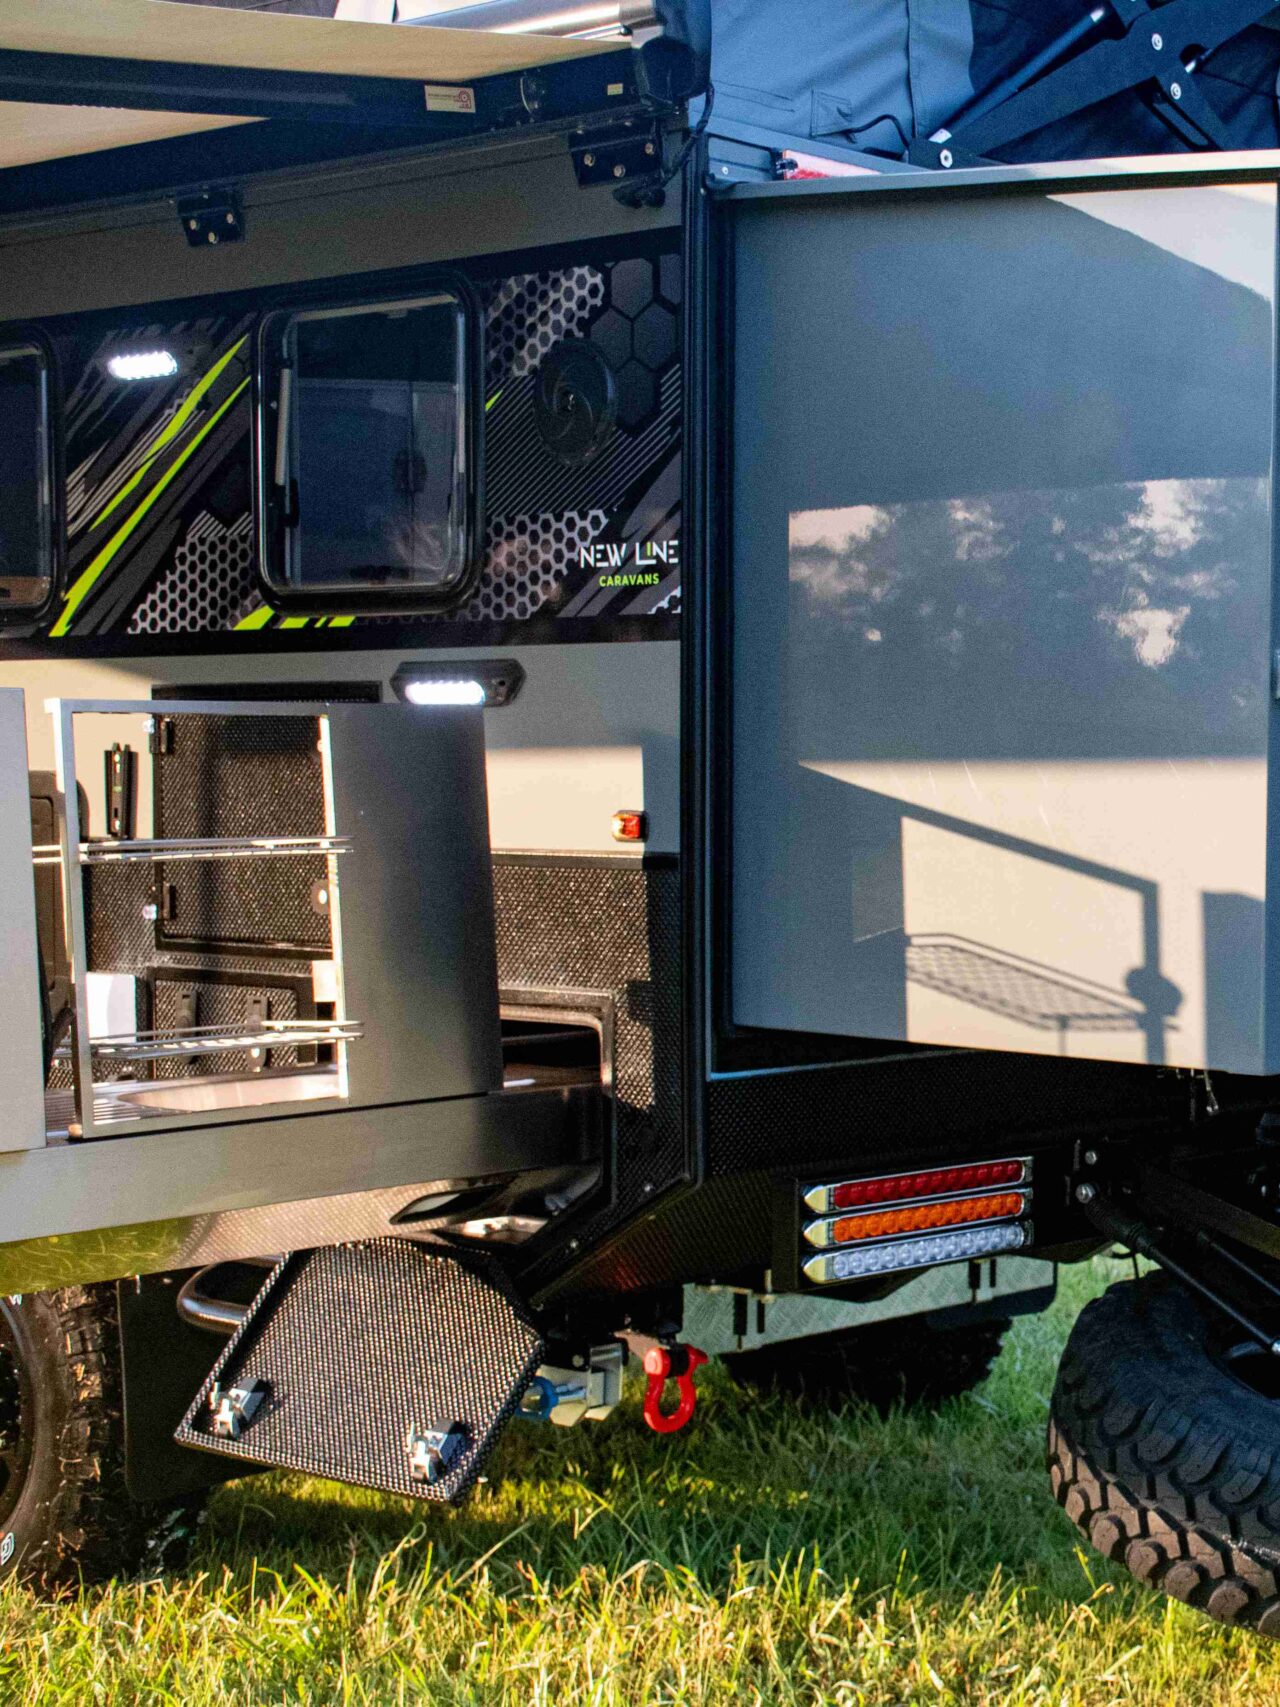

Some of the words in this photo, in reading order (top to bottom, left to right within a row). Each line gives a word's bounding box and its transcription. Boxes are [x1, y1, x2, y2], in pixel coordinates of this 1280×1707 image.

[580, 543, 627, 568] NEW
[635, 540, 679, 565] LINE
[599, 573, 660, 587] CARAVANS
